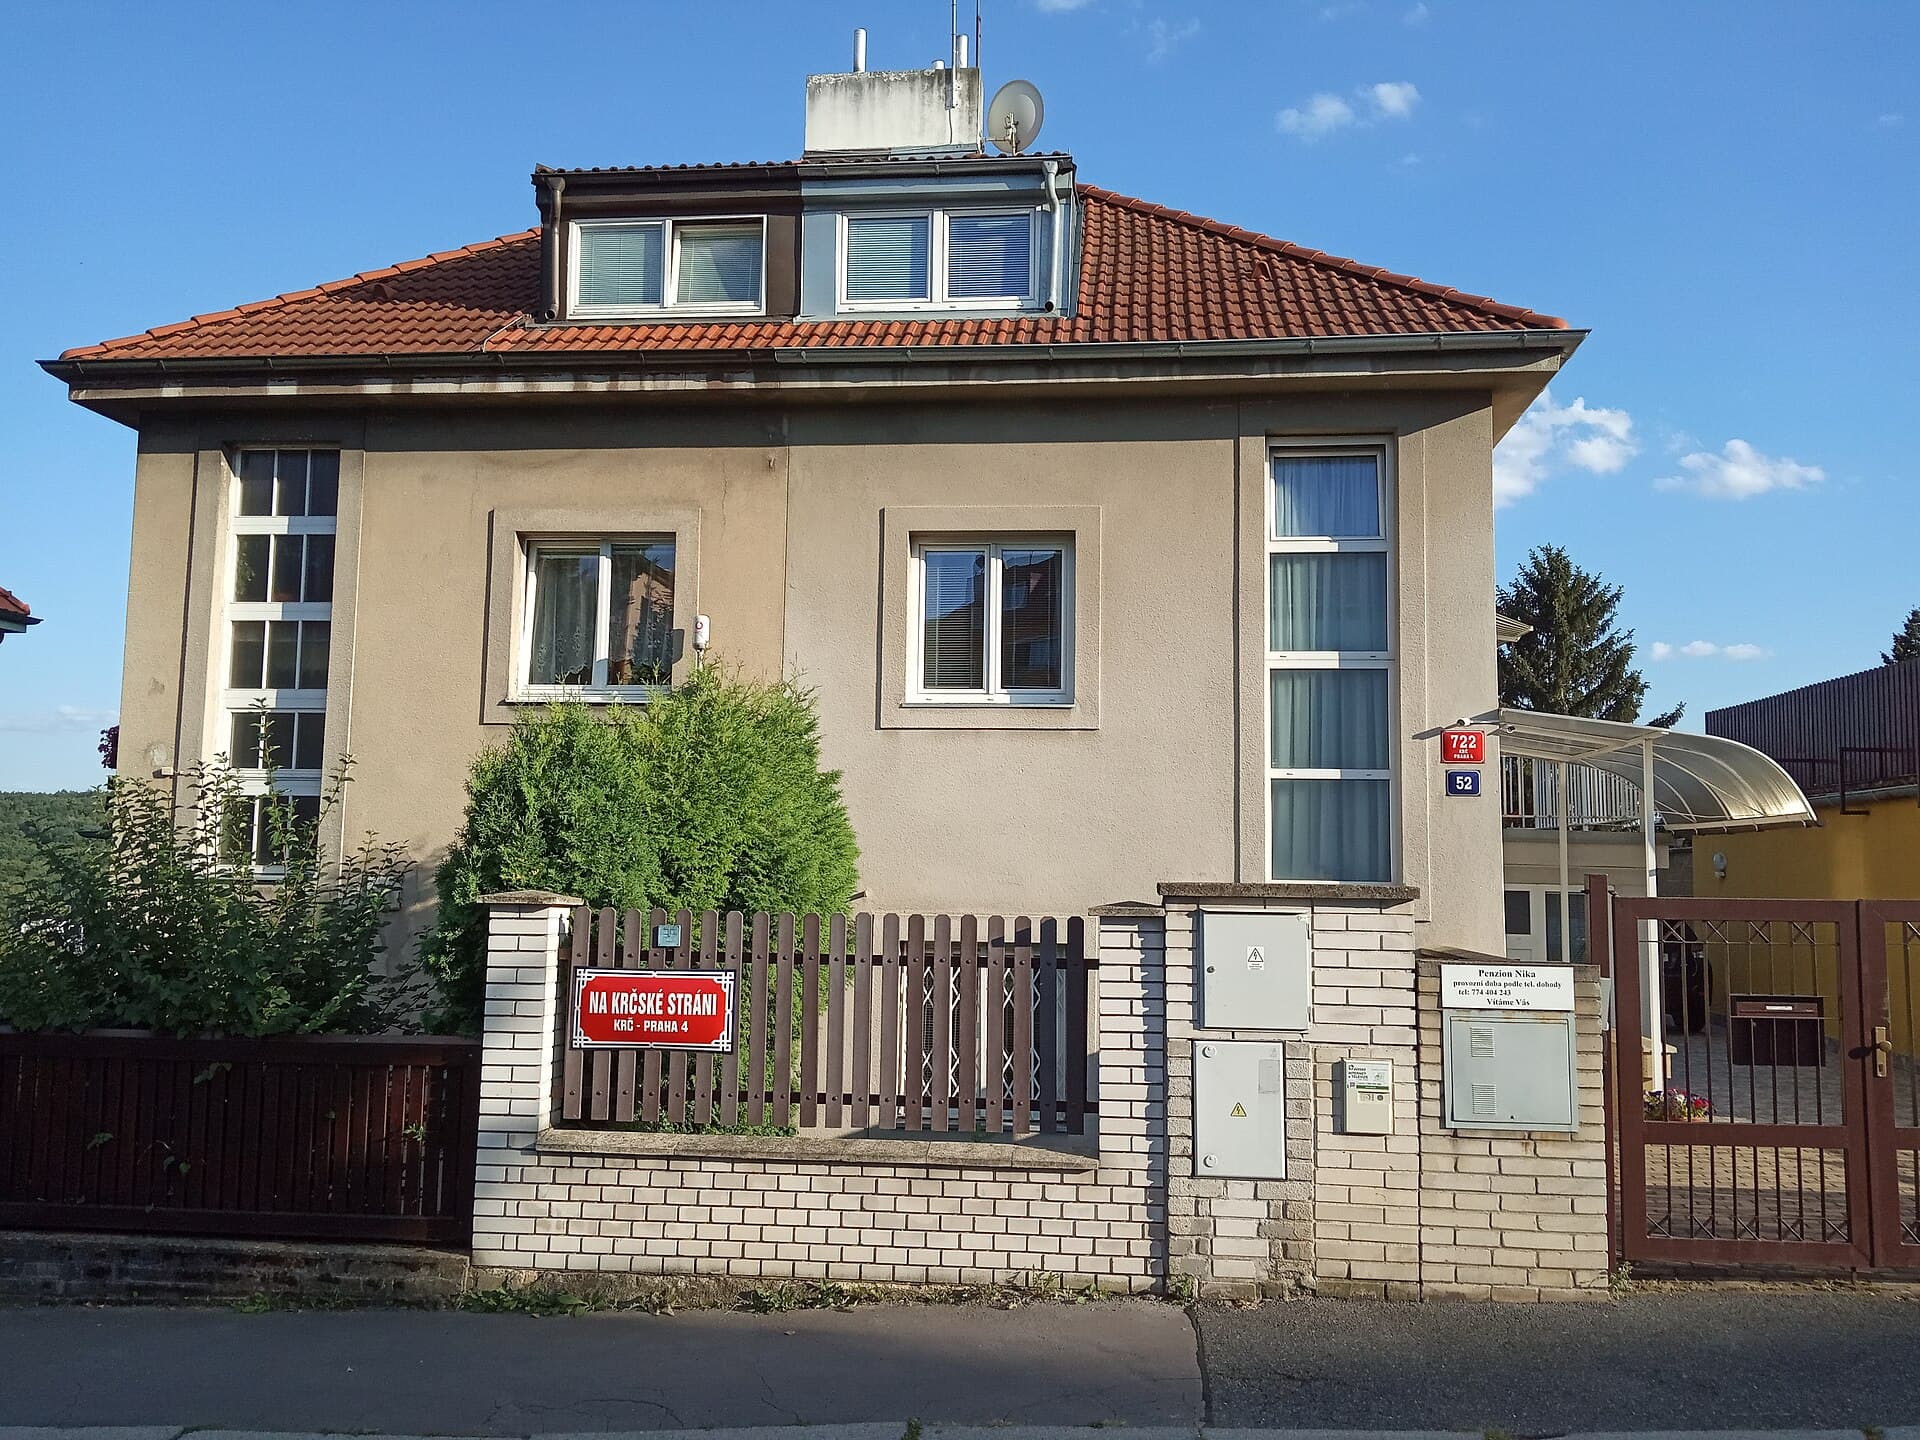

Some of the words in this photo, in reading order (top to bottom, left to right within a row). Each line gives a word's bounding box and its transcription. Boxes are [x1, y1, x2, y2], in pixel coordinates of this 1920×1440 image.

[1450, 734, 1477, 749] 722
[1455, 776, 1473, 790] 52
[1478, 969, 1513, 978] Penzion
[1515, 969, 1536, 978] Nika
[1453, 980, 1484, 988] provozní
[1536, 981, 1562, 989] dohody
[589, 991, 607, 1014] NA
[611, 988, 663, 1015] KRČSKÉ
[667, 989, 717, 1016] STRÁNI
[1486, 998, 1516, 1006] Vítáme
[1516, 998, 1530, 1006] Vás
[613, 1017, 634, 1031] KRČ
[643, 1020, 678, 1033] PRAHA
[681, 1020, 689, 1033] 4
